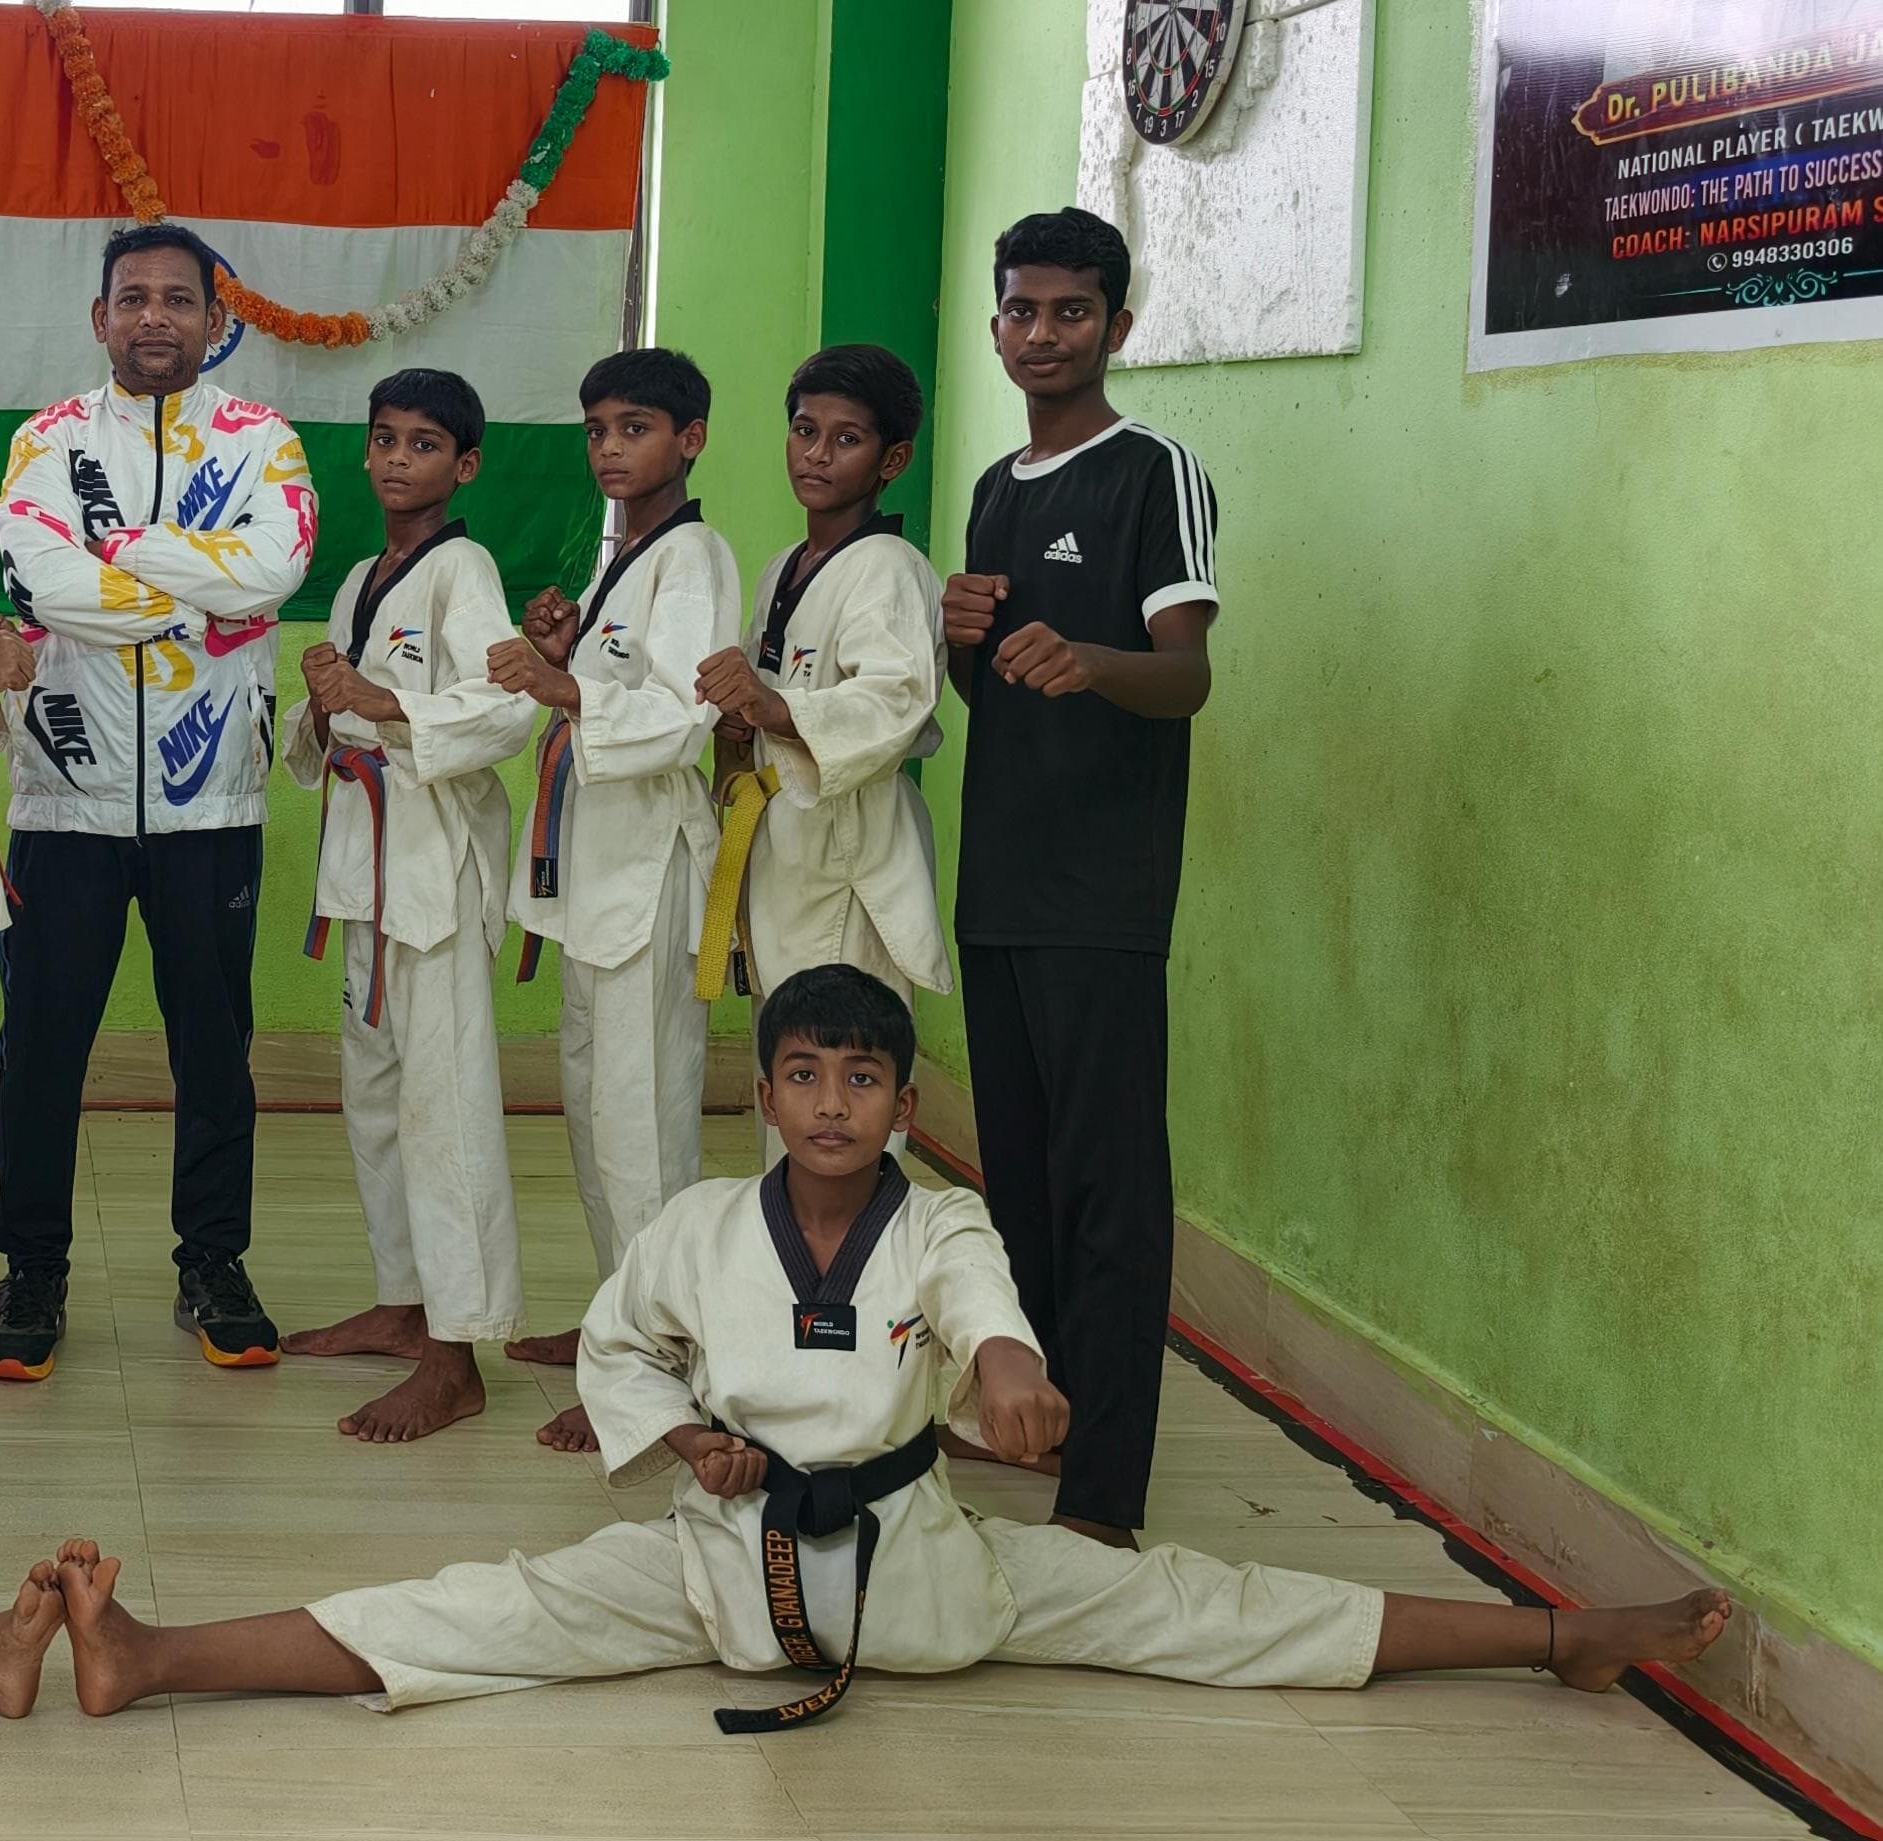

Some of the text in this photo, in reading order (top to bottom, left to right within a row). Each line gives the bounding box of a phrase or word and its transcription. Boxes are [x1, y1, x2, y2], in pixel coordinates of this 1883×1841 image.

[1215, 22, 1226, 42] 10
[1126, 47, 1133, 65] 8
[1204, 59, 1215, 79] 15
[1607, 93, 1641, 123] Dr.
[1651, 43, 1834, 112] PULIBANDA
[1136, 103, 1142, 120] 7
[1191, 89, 1199, 108] 2
[1144, 116, 1154, 134] 19
[1160, 119, 1167, 137] 3
[1175, 110, 1186, 129] 17
[1618, 142, 1707, 180] NATIONAL
[1713, 129, 1787, 164] PLAYER
[1605, 149, 1883, 222] TAEKWONDO: THE PATH TO SUCCESS
[1612, 226, 1692, 260] COACH:
[1700, 199, 1863, 248] NARSIPURAM
[1732, 236, 1854, 269] 9948330306
[176, 456, 225, 530] NIKE
[1044, 549, 1084, 564] adidas
[42, 693, 98, 766] NIKE
[157, 689, 217, 779] NIKE
[766, 1529, 804, 1629] GYANADEEP
